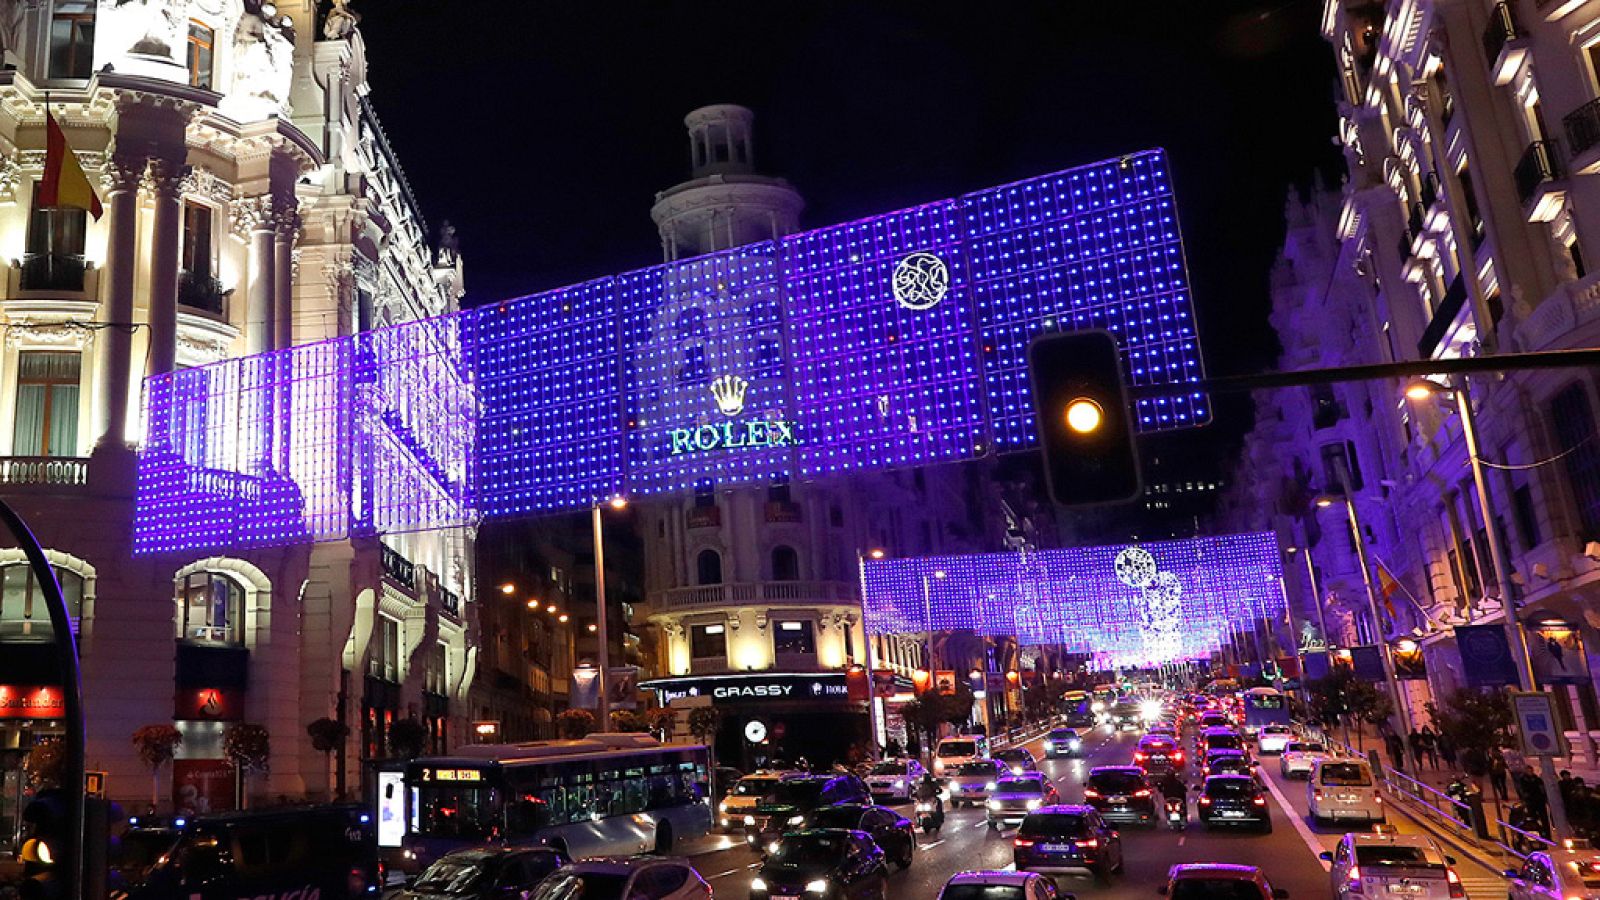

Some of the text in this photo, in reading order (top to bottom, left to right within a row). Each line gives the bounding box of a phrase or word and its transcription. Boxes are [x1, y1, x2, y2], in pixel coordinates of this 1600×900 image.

[670, 420, 797, 454] ROLEX
[713, 685, 793, 698] GRASSY
[422, 768, 431, 781] 2
